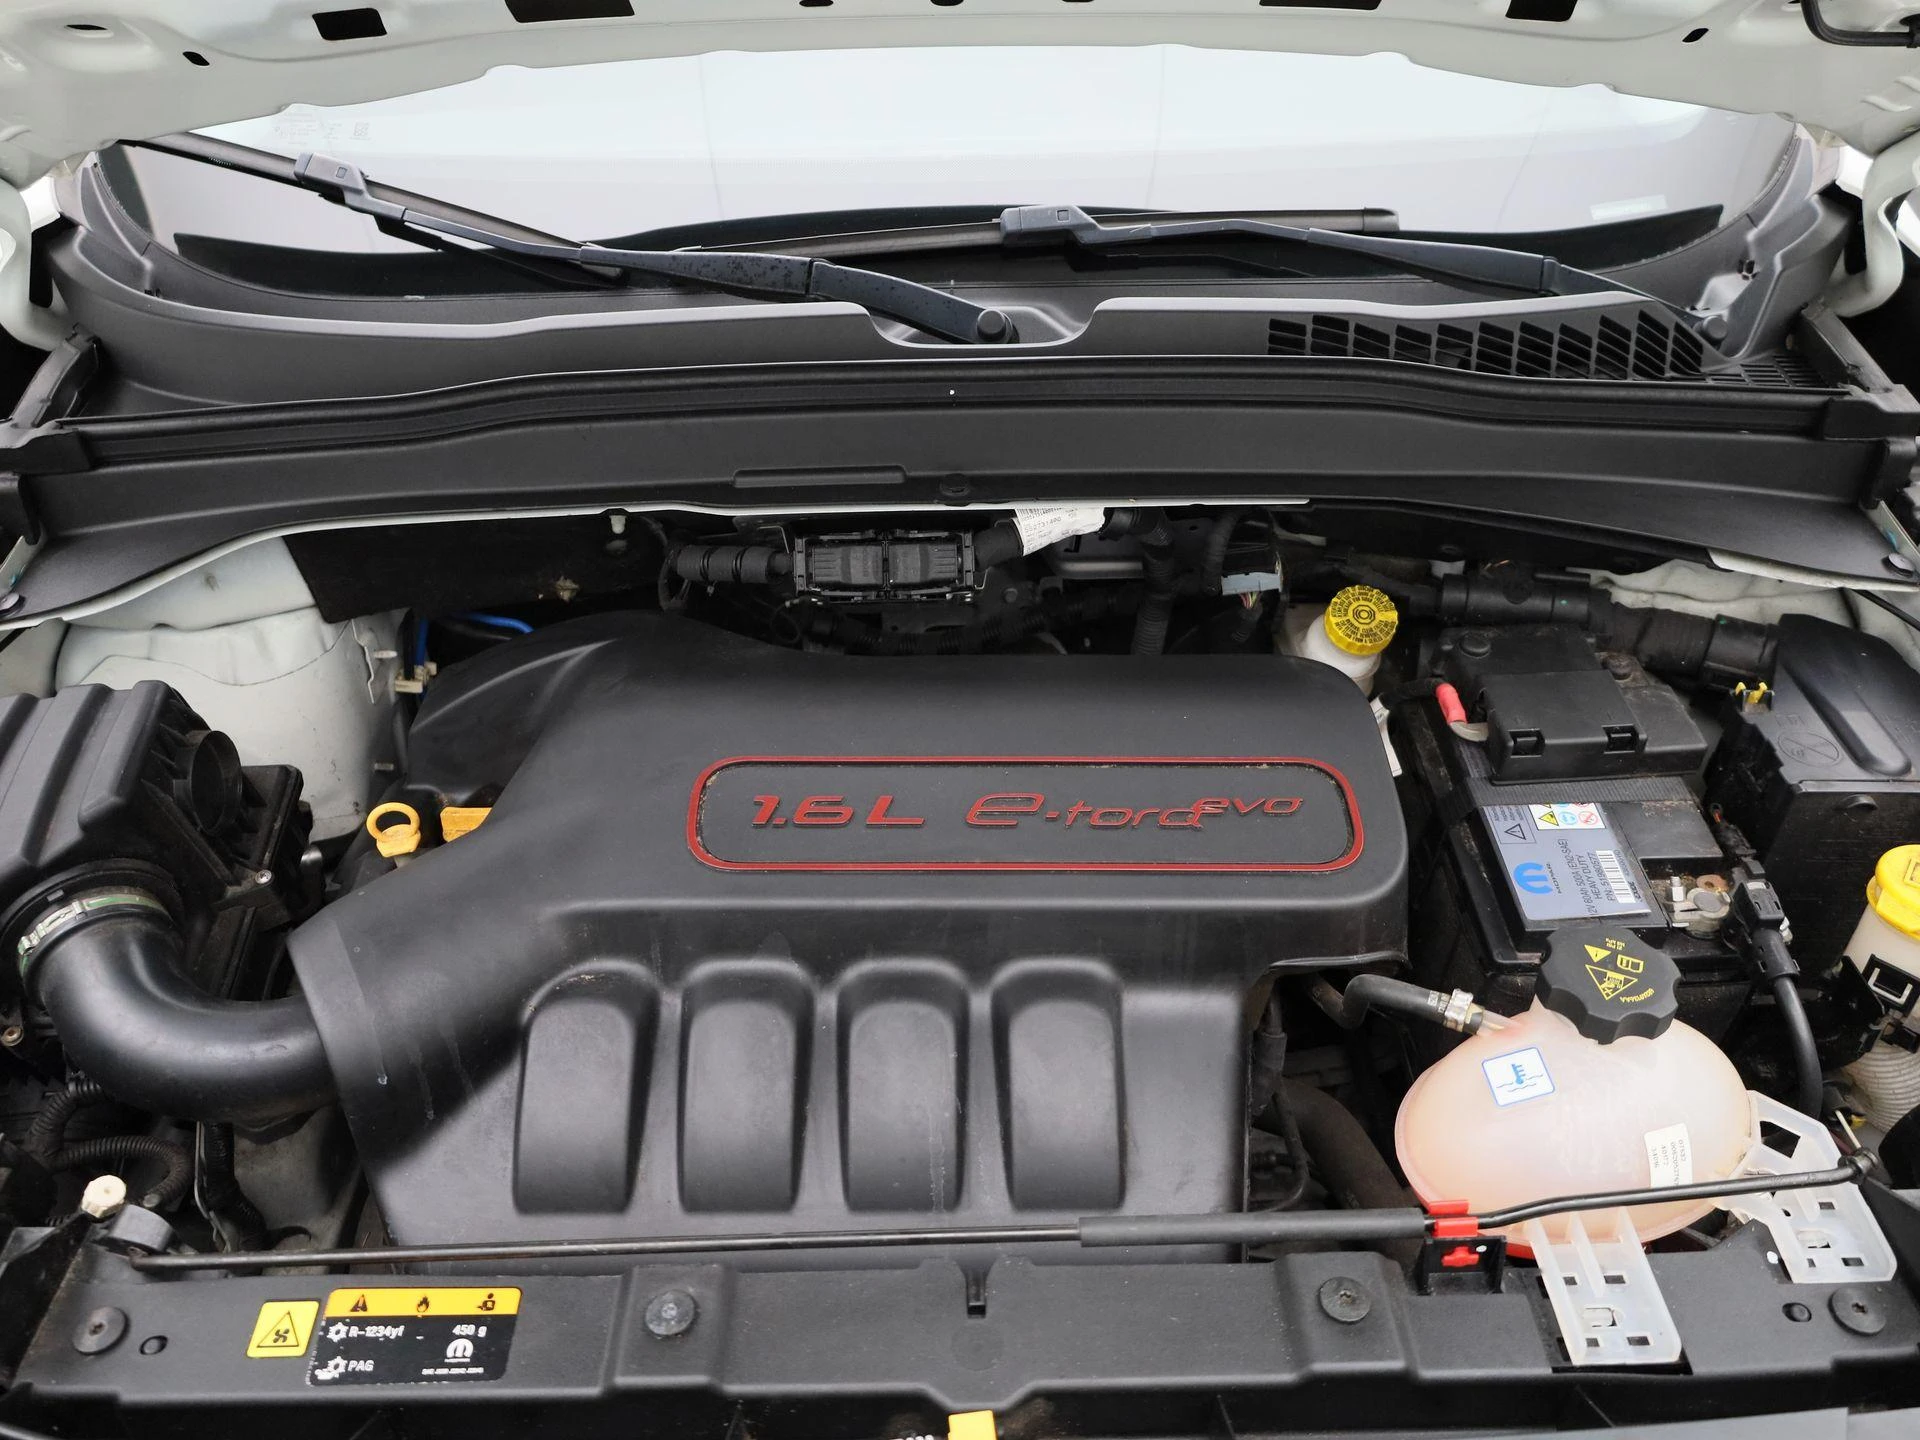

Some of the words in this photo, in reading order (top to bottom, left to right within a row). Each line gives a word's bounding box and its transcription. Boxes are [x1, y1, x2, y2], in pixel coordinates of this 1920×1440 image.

[752, 795, 854, 827] 1.6
[865, 795, 926, 825] L
[1193, 797, 1304, 815] evo
[1575, 854, 1592, 875] DUTY
[1585, 875, 1603, 900] HEAVY
[348, 1325, 405, 1339] R-1234yf
[347, 1359, 375, 1372] PAG
